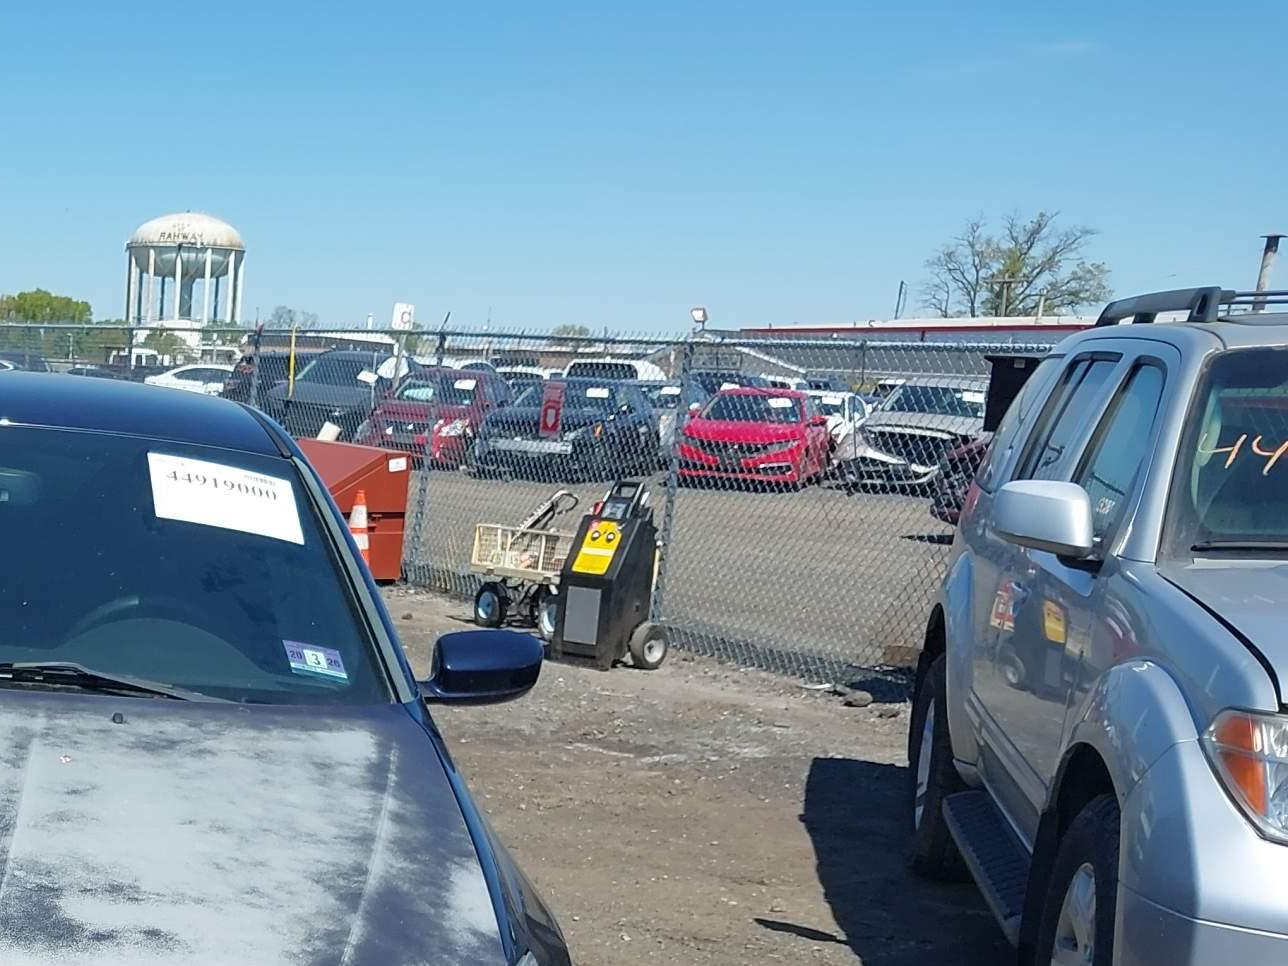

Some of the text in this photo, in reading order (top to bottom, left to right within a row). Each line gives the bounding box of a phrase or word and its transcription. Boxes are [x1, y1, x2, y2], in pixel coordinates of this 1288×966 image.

[160, 231, 203, 241] RAHWAY
[166, 470, 278, 502] 44919000
[311, 653, 321, 665] 3
